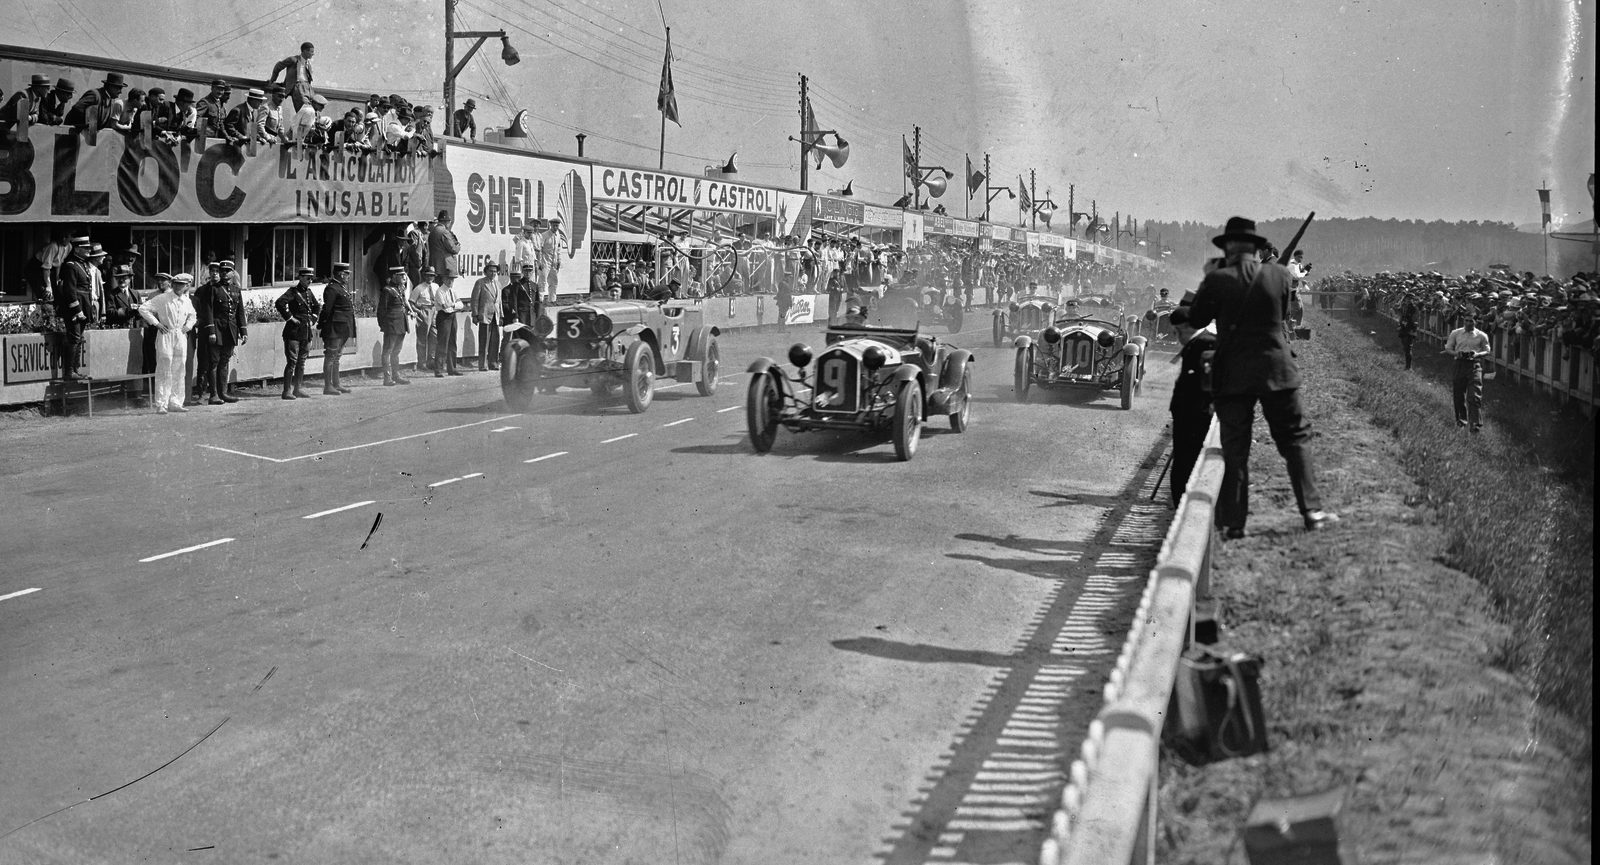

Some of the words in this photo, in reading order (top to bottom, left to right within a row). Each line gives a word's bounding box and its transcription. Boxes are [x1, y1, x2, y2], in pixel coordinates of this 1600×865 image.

[296, 190, 409, 217] INUSABLE
[466, 172, 548, 235] SHELL
[603, 169, 687, 203] CASTROL
[709, 182, 772, 212] CASTROL
[566, 319, 581, 339] 3
[671, 326, 680, 355] 3
[11, 343, 50, 373] SERVICE
[1065, 340, 1091, 368] 10
[823, 358, 847, 406] 9
